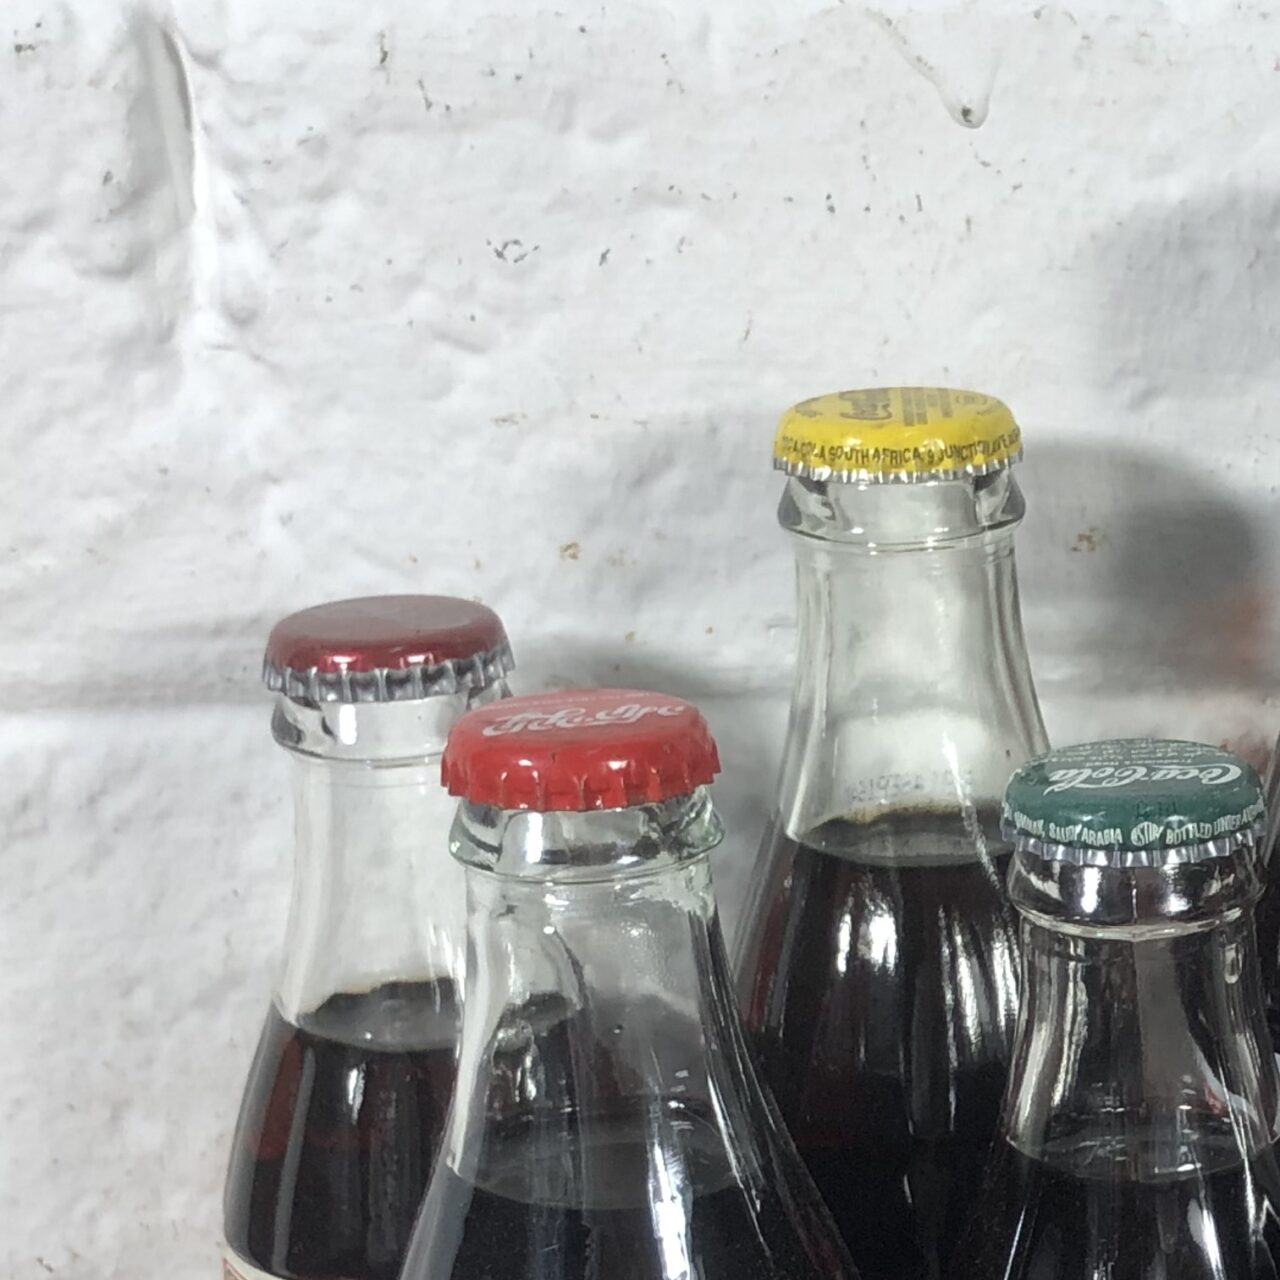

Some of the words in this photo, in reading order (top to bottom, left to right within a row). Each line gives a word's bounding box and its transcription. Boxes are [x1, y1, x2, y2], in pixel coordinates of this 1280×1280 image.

[829, 444, 869, 464] SOUTH
[1043, 762, 1242, 796] Coca-Cola
[1082, 827, 1123, 847] ARABIA
[1166, 822, 1212, 845] BOTTLED
